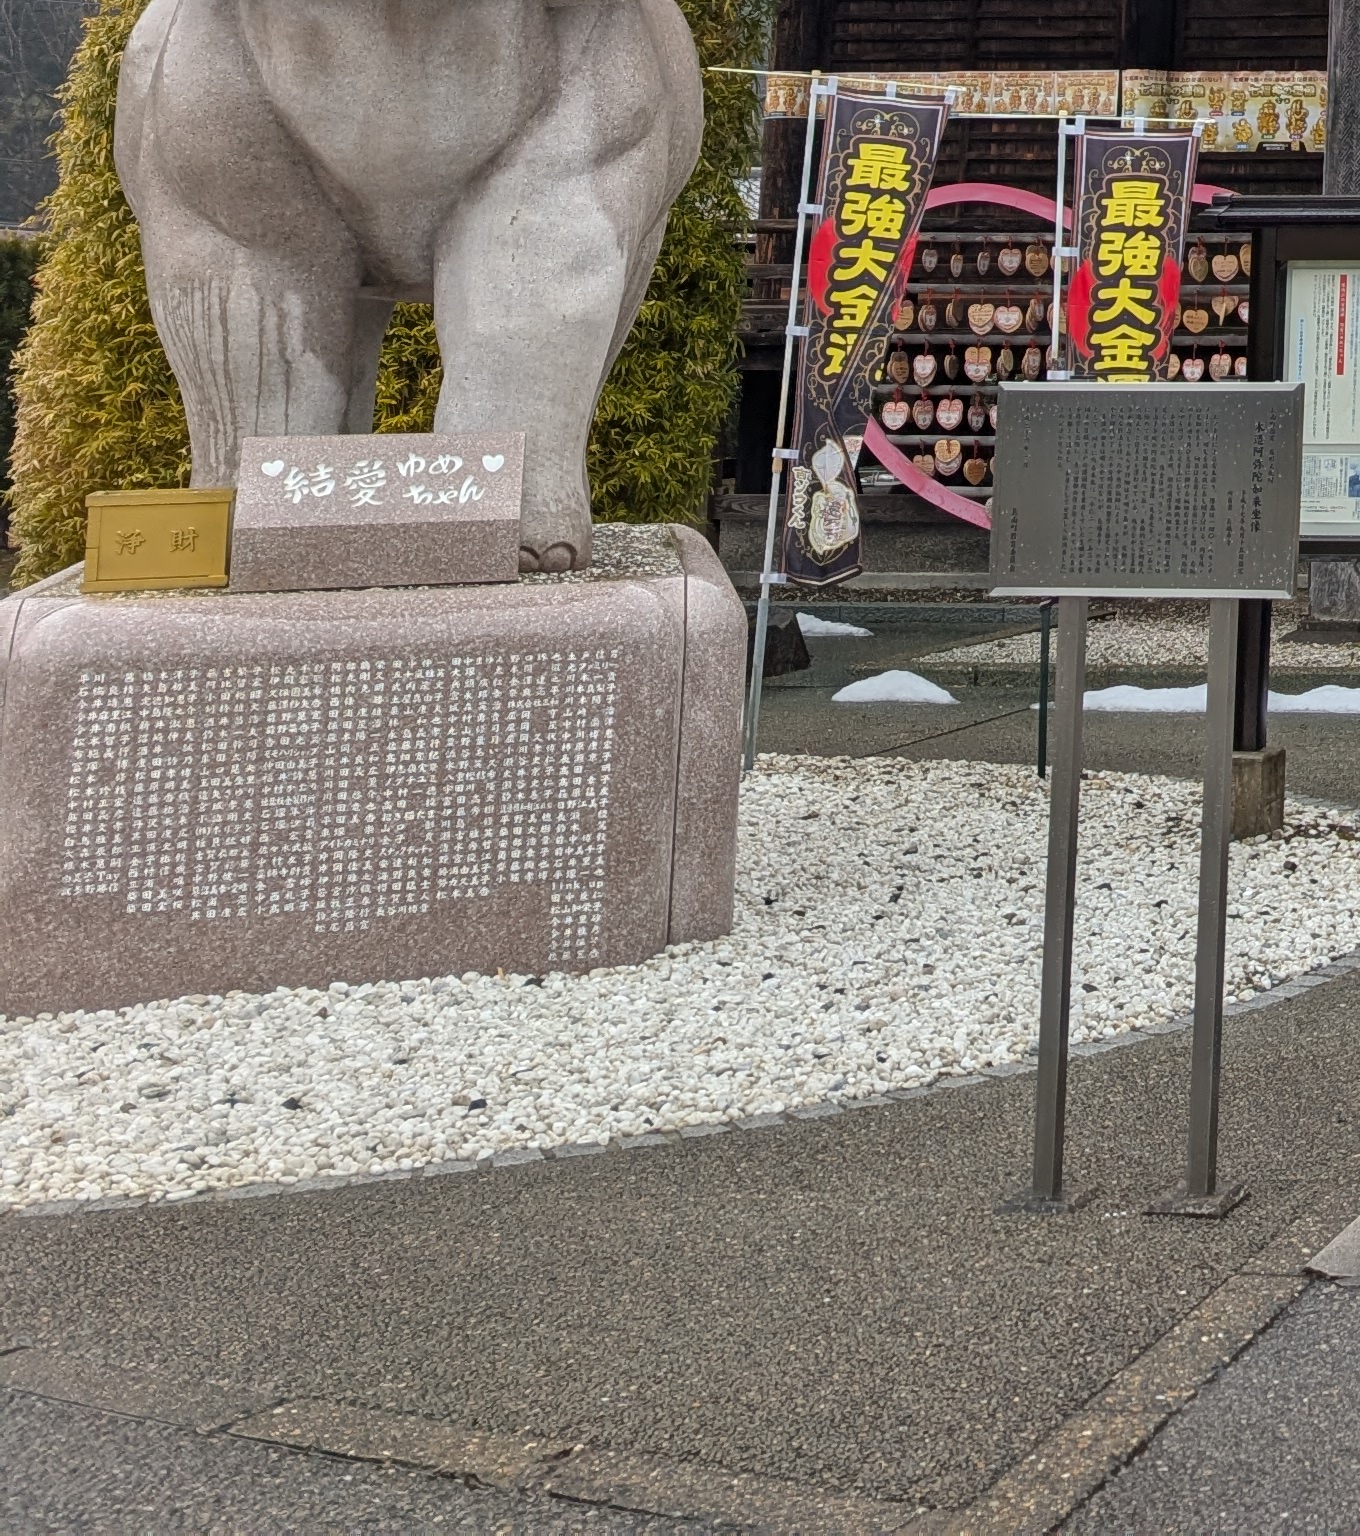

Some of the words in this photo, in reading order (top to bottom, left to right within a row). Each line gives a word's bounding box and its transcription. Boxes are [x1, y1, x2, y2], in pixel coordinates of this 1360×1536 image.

[1090, 181, 1166, 382] 最強大金
[283, 463, 386, 507] 結愛
[398, 453, 463, 477] ゆめ
[1250, 421, 1265, 533] 木造阿弥陀如来坐像
[402, 475, 485, 505] ちゃん
[787, 465, 807, 529] 吉ゾウくん
[116, 526, 199, 555] 浄財
